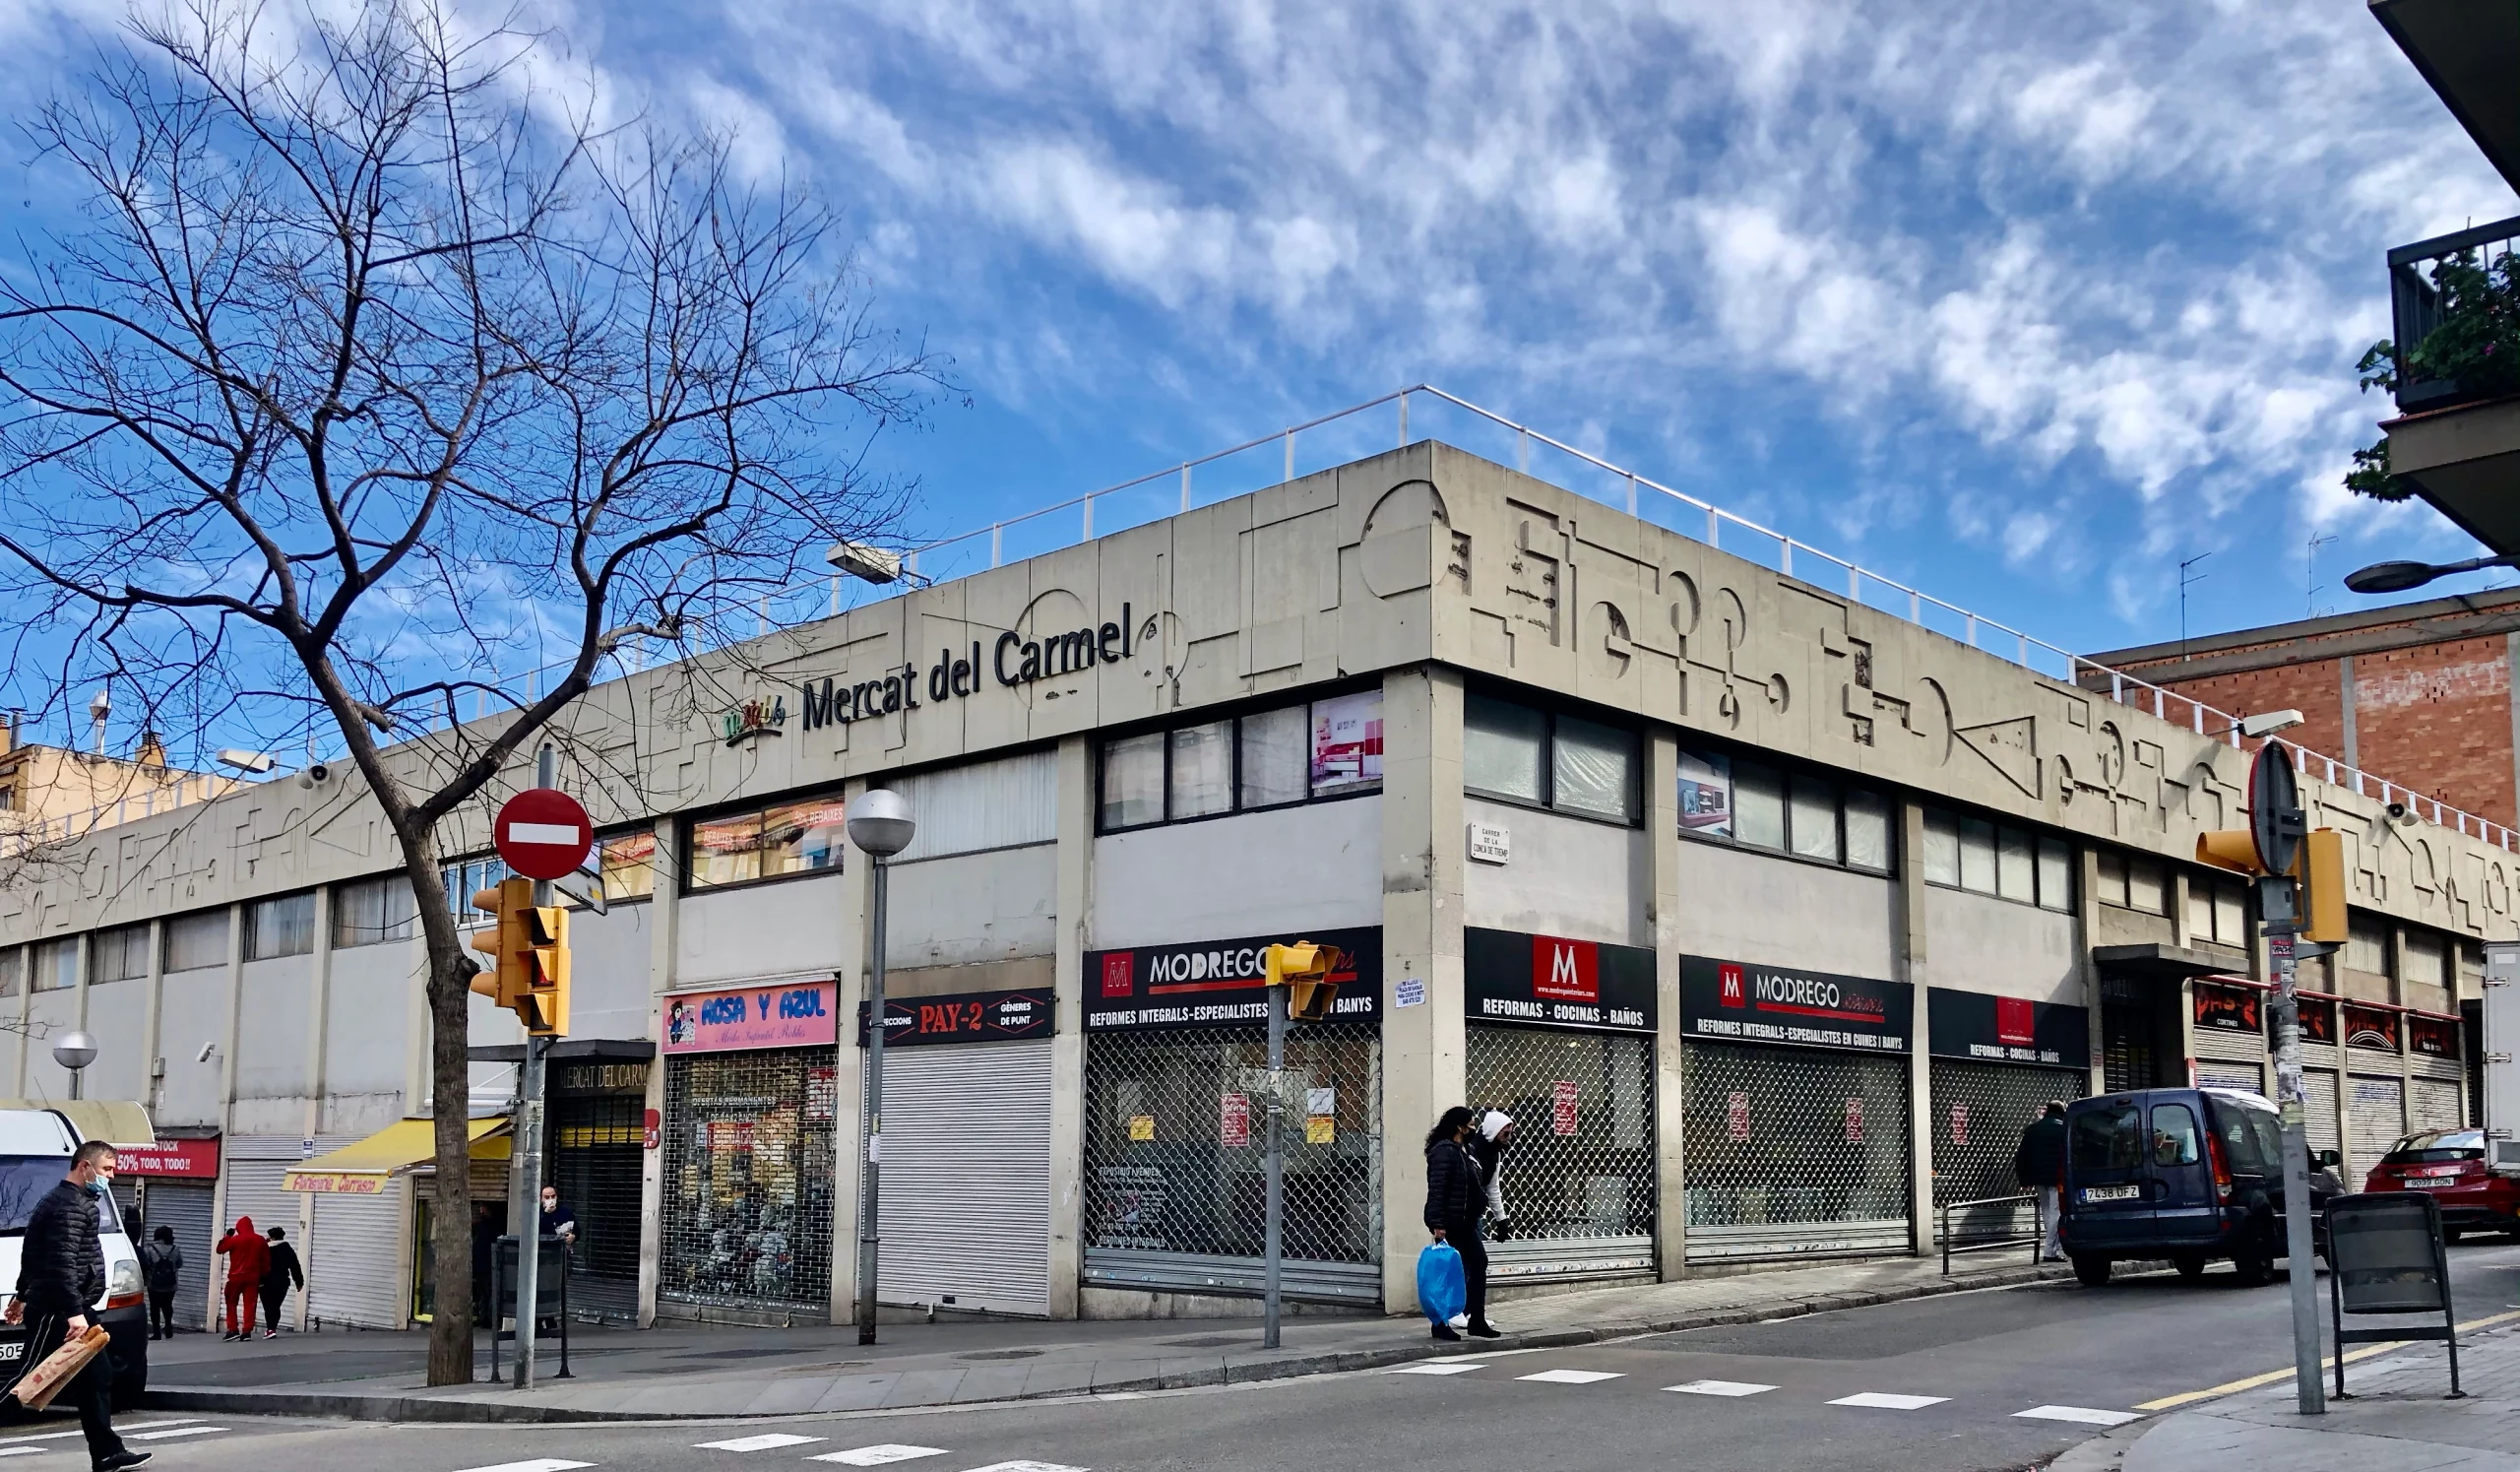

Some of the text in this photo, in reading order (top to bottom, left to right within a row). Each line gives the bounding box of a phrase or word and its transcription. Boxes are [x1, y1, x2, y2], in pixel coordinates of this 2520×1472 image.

[803, 602, 1132, 731] Mercat del Carmel
[809, 807, 844, 825] REBAIXES
[1481, 828, 1501, 837] CARRER
[1487, 846, 1493, 856] DE
[1107, 961, 1128, 988] M
[1550, 943, 1579, 985] M
[1724, 971, 1740, 998] M
[1756, 973, 1840, 1008] MODREGO
[701, 988, 826, 1025] ROSA Y AZUL
[919, 1001, 983, 1034] PAY-2
[1000, 1000, 1032, 1013] GÈNERES
[1090, 1008, 1136, 1027] REFORMES
[1139, 1002, 1269, 1024] INTEGRALS-ESPECIALISTES
[1337, 995, 1373, 1014] BANYS
[1482, 997, 1544, 1018] REFORMAS
[1553, 1004, 1601, 1023] COCINAS
[1609, 1007, 1644, 1026] BAÑOS
[1000, 1015, 1032, 1026] DE PUNT
[1697, 1018, 1741, 1036] REFORMES
[1742, 1022, 1842, 1044] INTEGRALS-ESPECIALISTES
[1843, 1032, 1852, 1045] EN
[1853, 1033, 1877, 1048] CUINES
[1882, 1035, 1903, 1051] BANYS
[1970, 1044, 2005, 1058] REFORMAS
[2009, 1047, 2036, 1061] COCINAS
[2041, 1049, 2059, 1063] BAÑOS
[560, 1065, 597, 1088] MERCAT
[598, 1064, 616, 1087] DEL
[117, 1153, 139, 1172] 50%
[140, 1157, 162, 1172] TODO,
[337, 1173, 376, 1192] Carrasco
[2087, 1187, 2114, 1200] 7438
